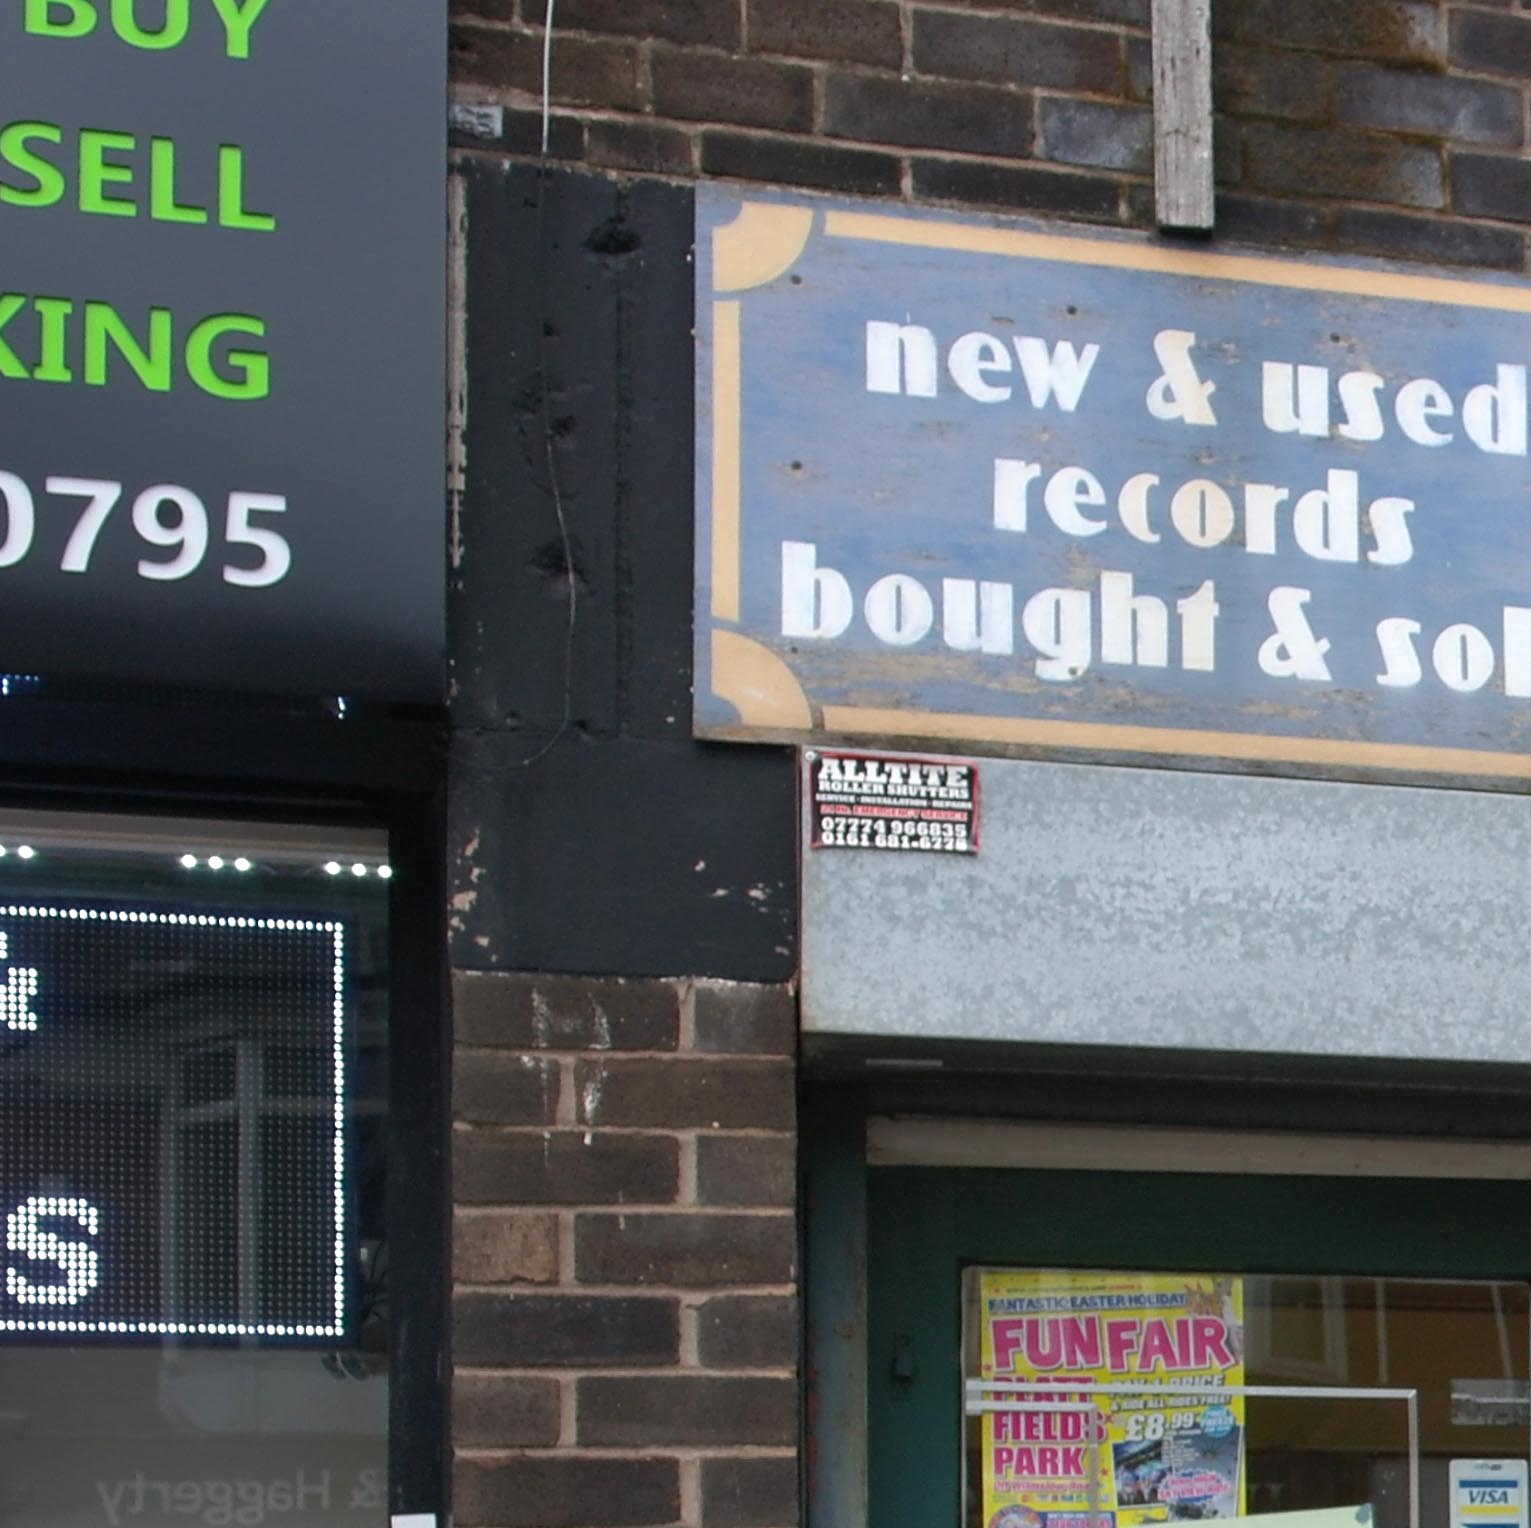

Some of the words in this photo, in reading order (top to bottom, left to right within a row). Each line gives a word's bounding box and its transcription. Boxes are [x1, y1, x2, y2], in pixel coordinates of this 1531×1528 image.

[0, 120, 276, 231] SELL
[866, 318, 1100, 412] new
[1146, 328, 1218, 426] &
[1262, 363, 1527, 456] used
[993, 458, 1416, 566] records
[781, 541, 1220, 680] bought
[1258, 586, 1332, 681] &
[818, 758, 968, 787] ALLTITE
[818, 780, 885, 794] ROLLER
[887, 784, 969, 799] SHUTTERS
[821, 817, 886, 833] 07774
[821, 831, 870, 847] 0161
[1070, 1295, 1126, 1309] EASTER
[991, 1314, 1102, 1371] FUN
[1106, 1316, 1235, 1373] FAIR
[993, 1411, 1107, 1441] FIELDS
[993, 1447, 1084, 1476] PARK
[1468, 1490, 1509, 1505] VISA
